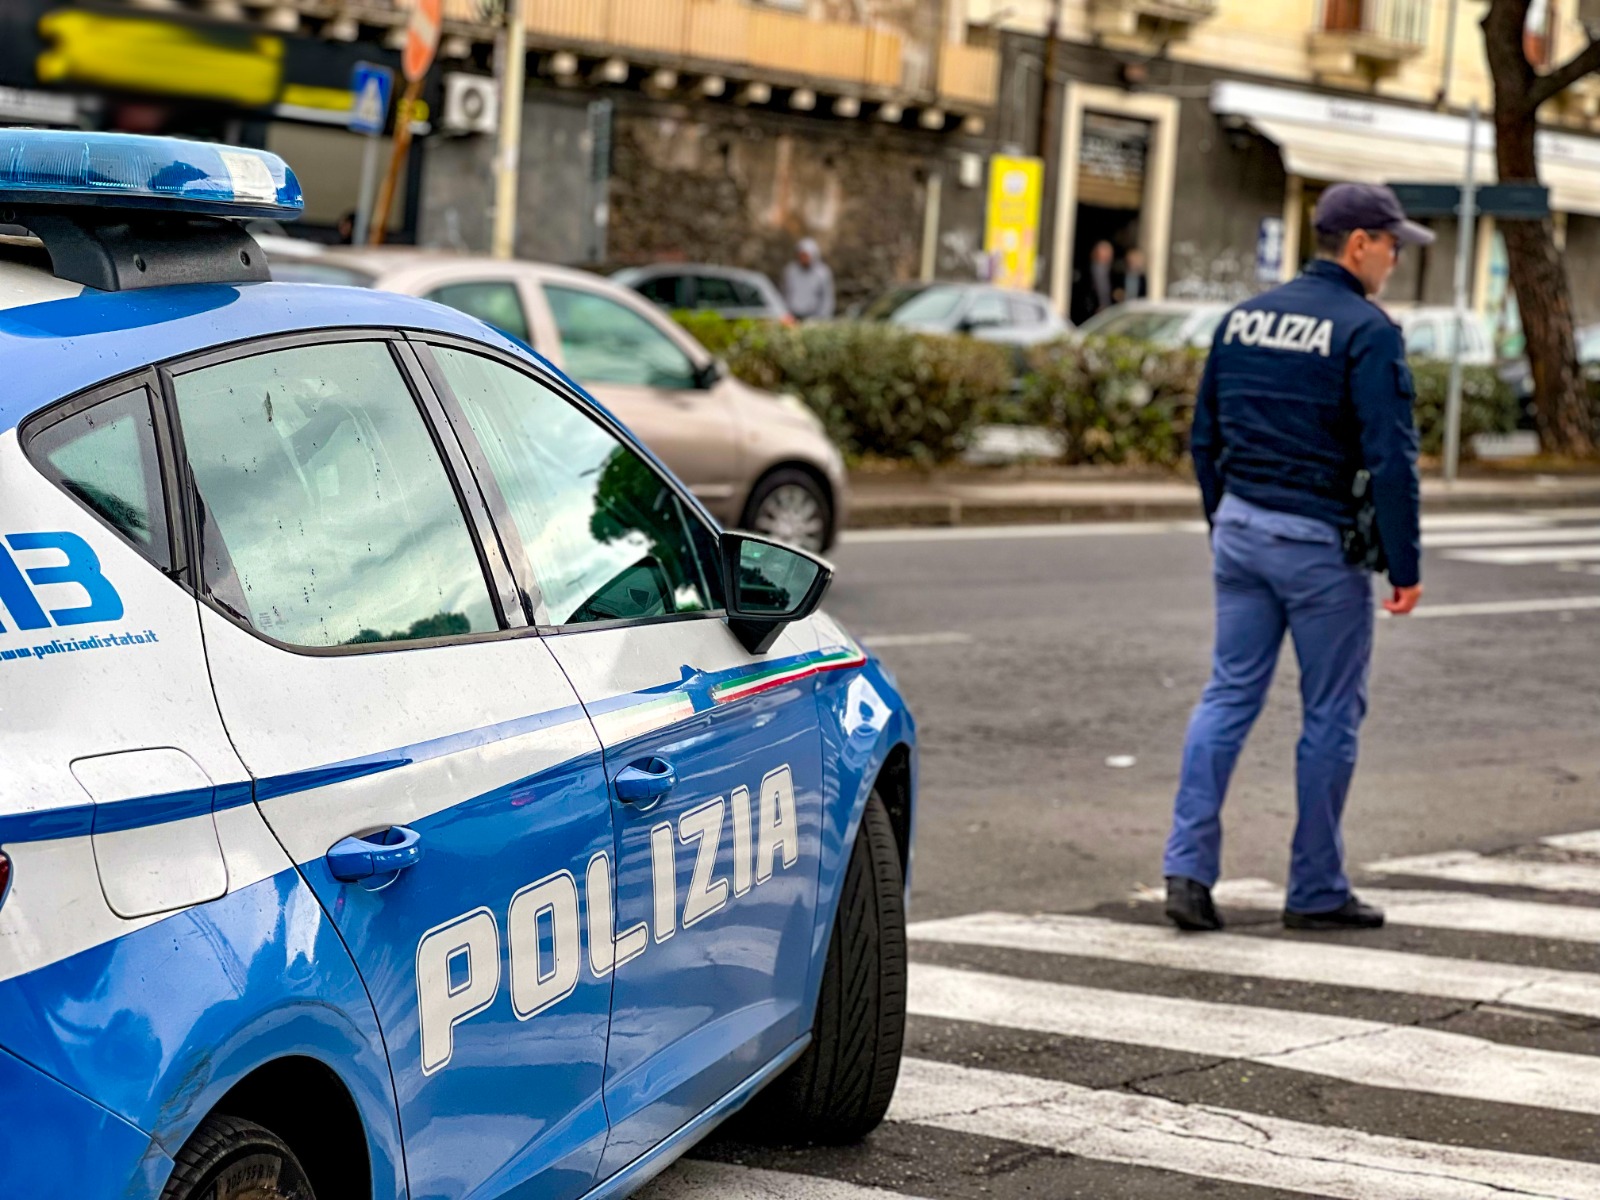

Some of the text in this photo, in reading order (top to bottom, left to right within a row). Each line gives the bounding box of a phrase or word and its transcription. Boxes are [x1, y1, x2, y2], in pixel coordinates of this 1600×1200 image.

[1223, 309, 1333, 357] POLIZIA
[0, 629, 159, 661] ww.poliziadistato.it
[415, 763, 799, 1077] POLIZIA
